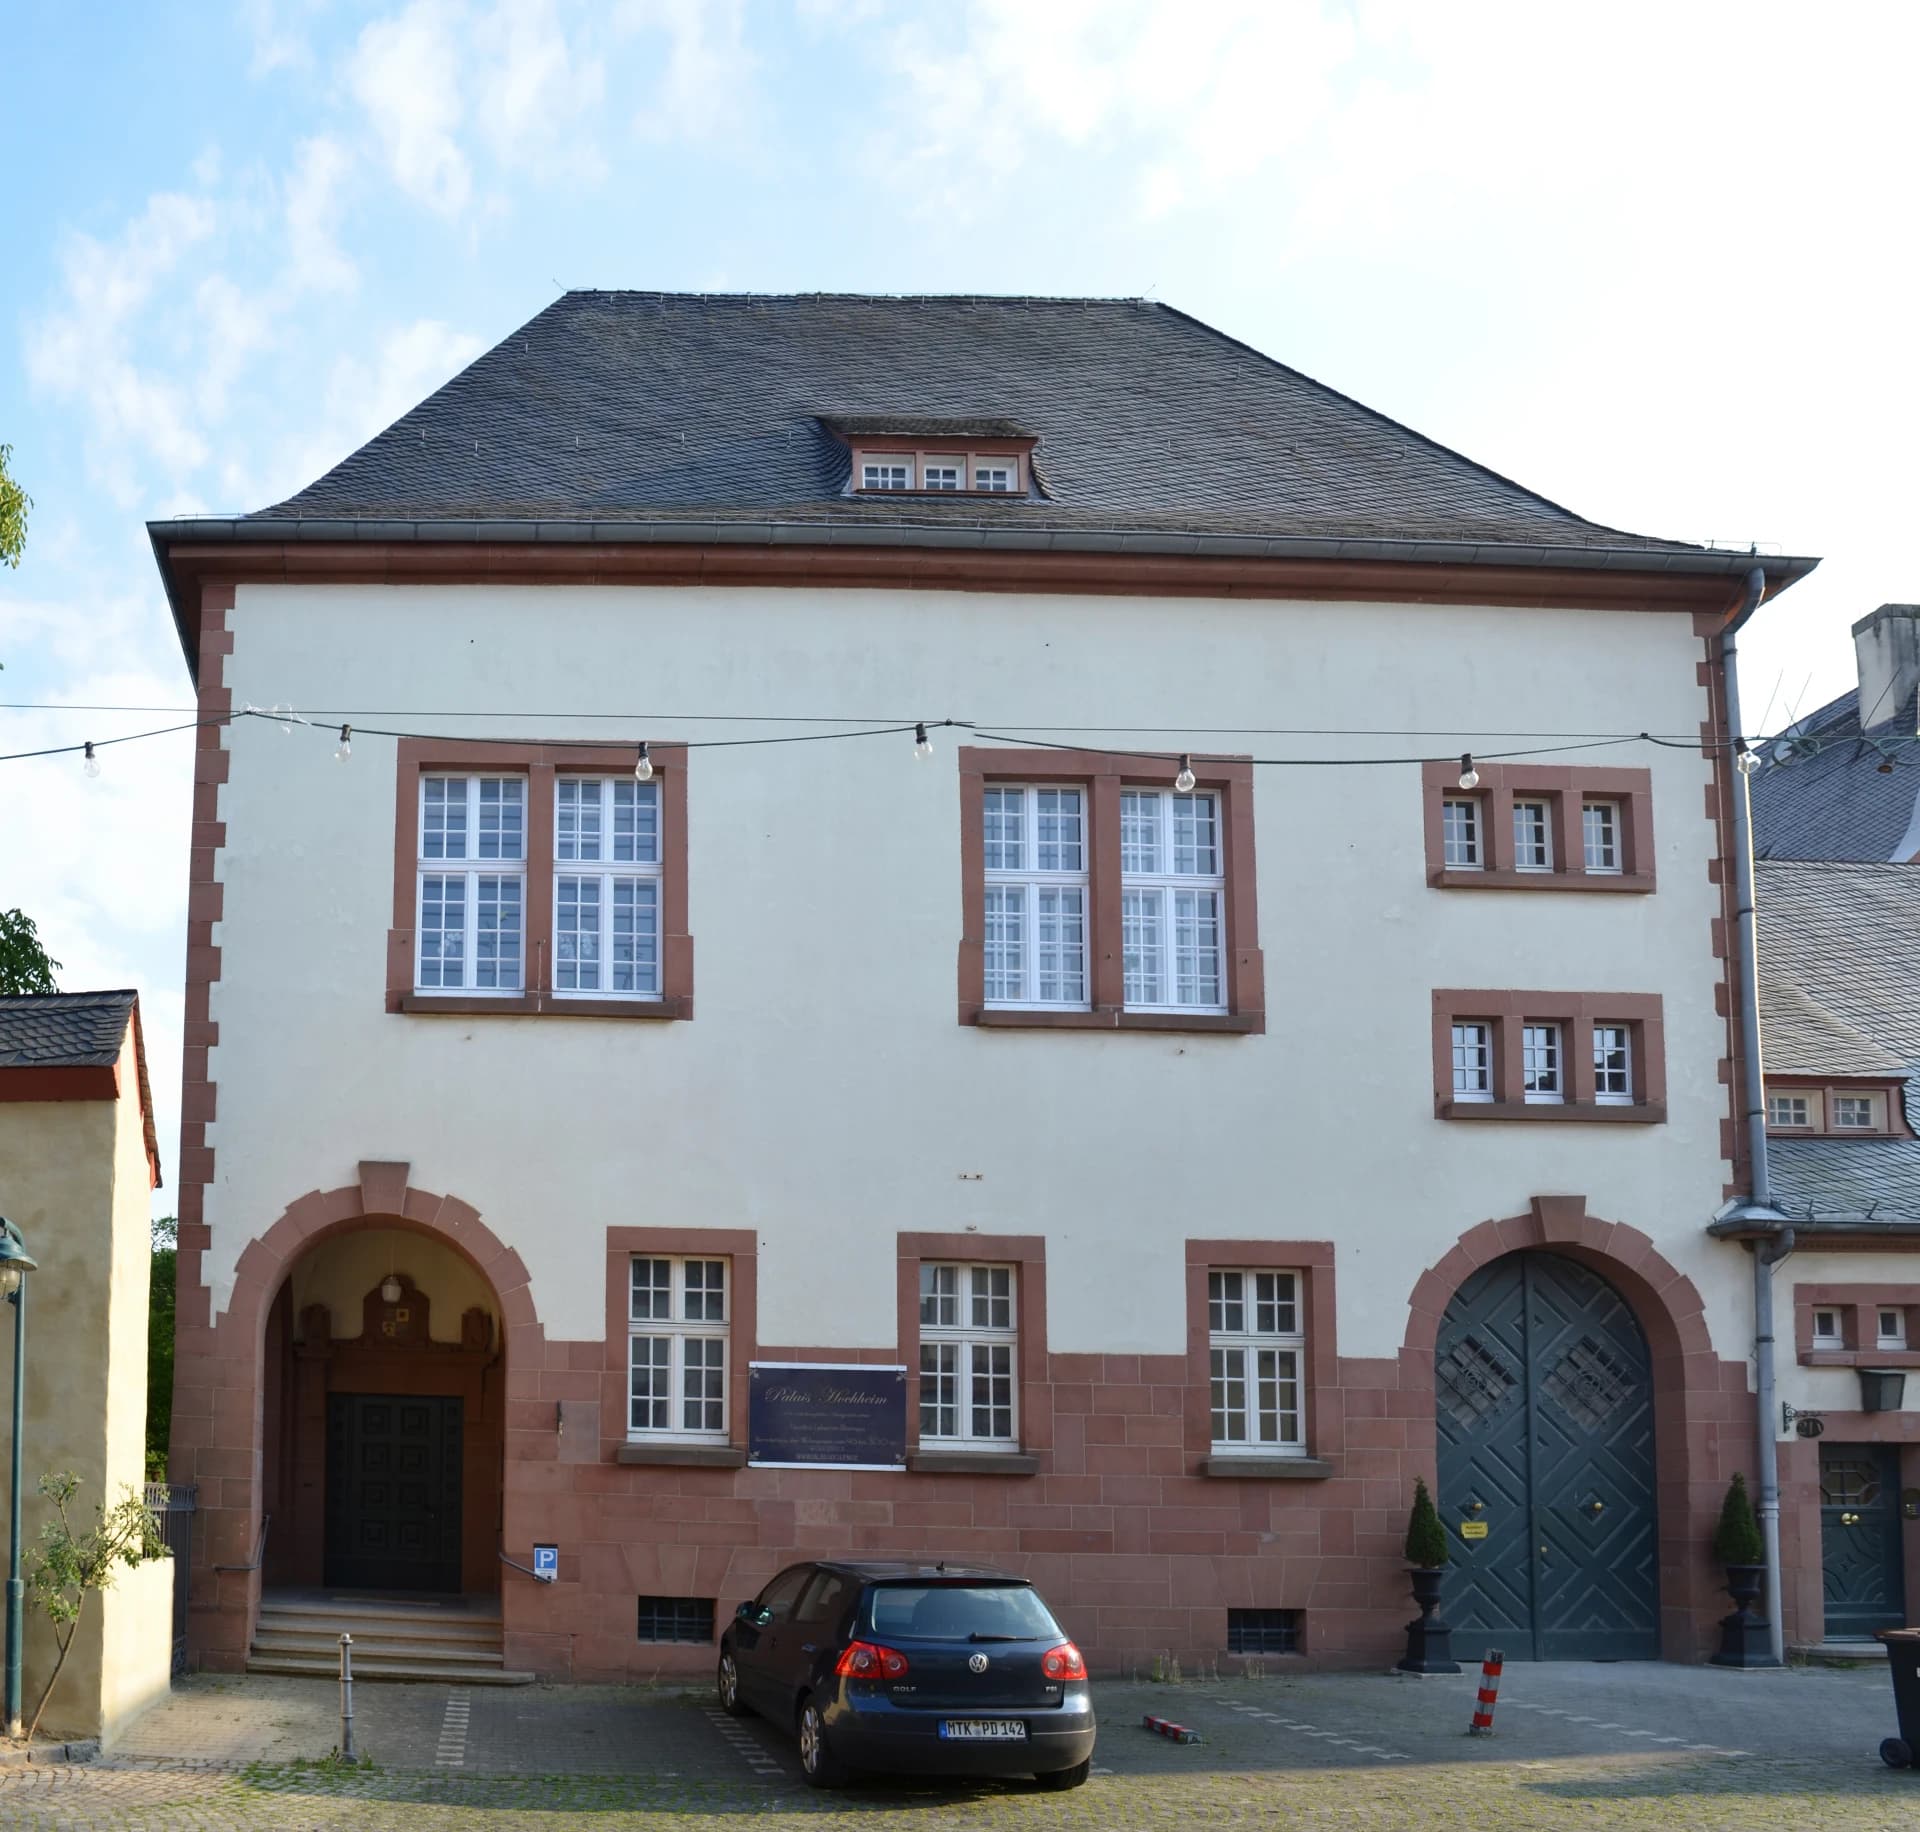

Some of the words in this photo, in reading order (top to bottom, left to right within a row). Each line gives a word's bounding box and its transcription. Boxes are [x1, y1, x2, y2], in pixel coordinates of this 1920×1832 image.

[765, 1386, 809, 1403] Palais
[540, 1550, 554, 1568] P
[947, 1721, 972, 1736] MTK
[981, 1721, 998, 1736] PD
[1000, 1721, 1024, 1736] 142
